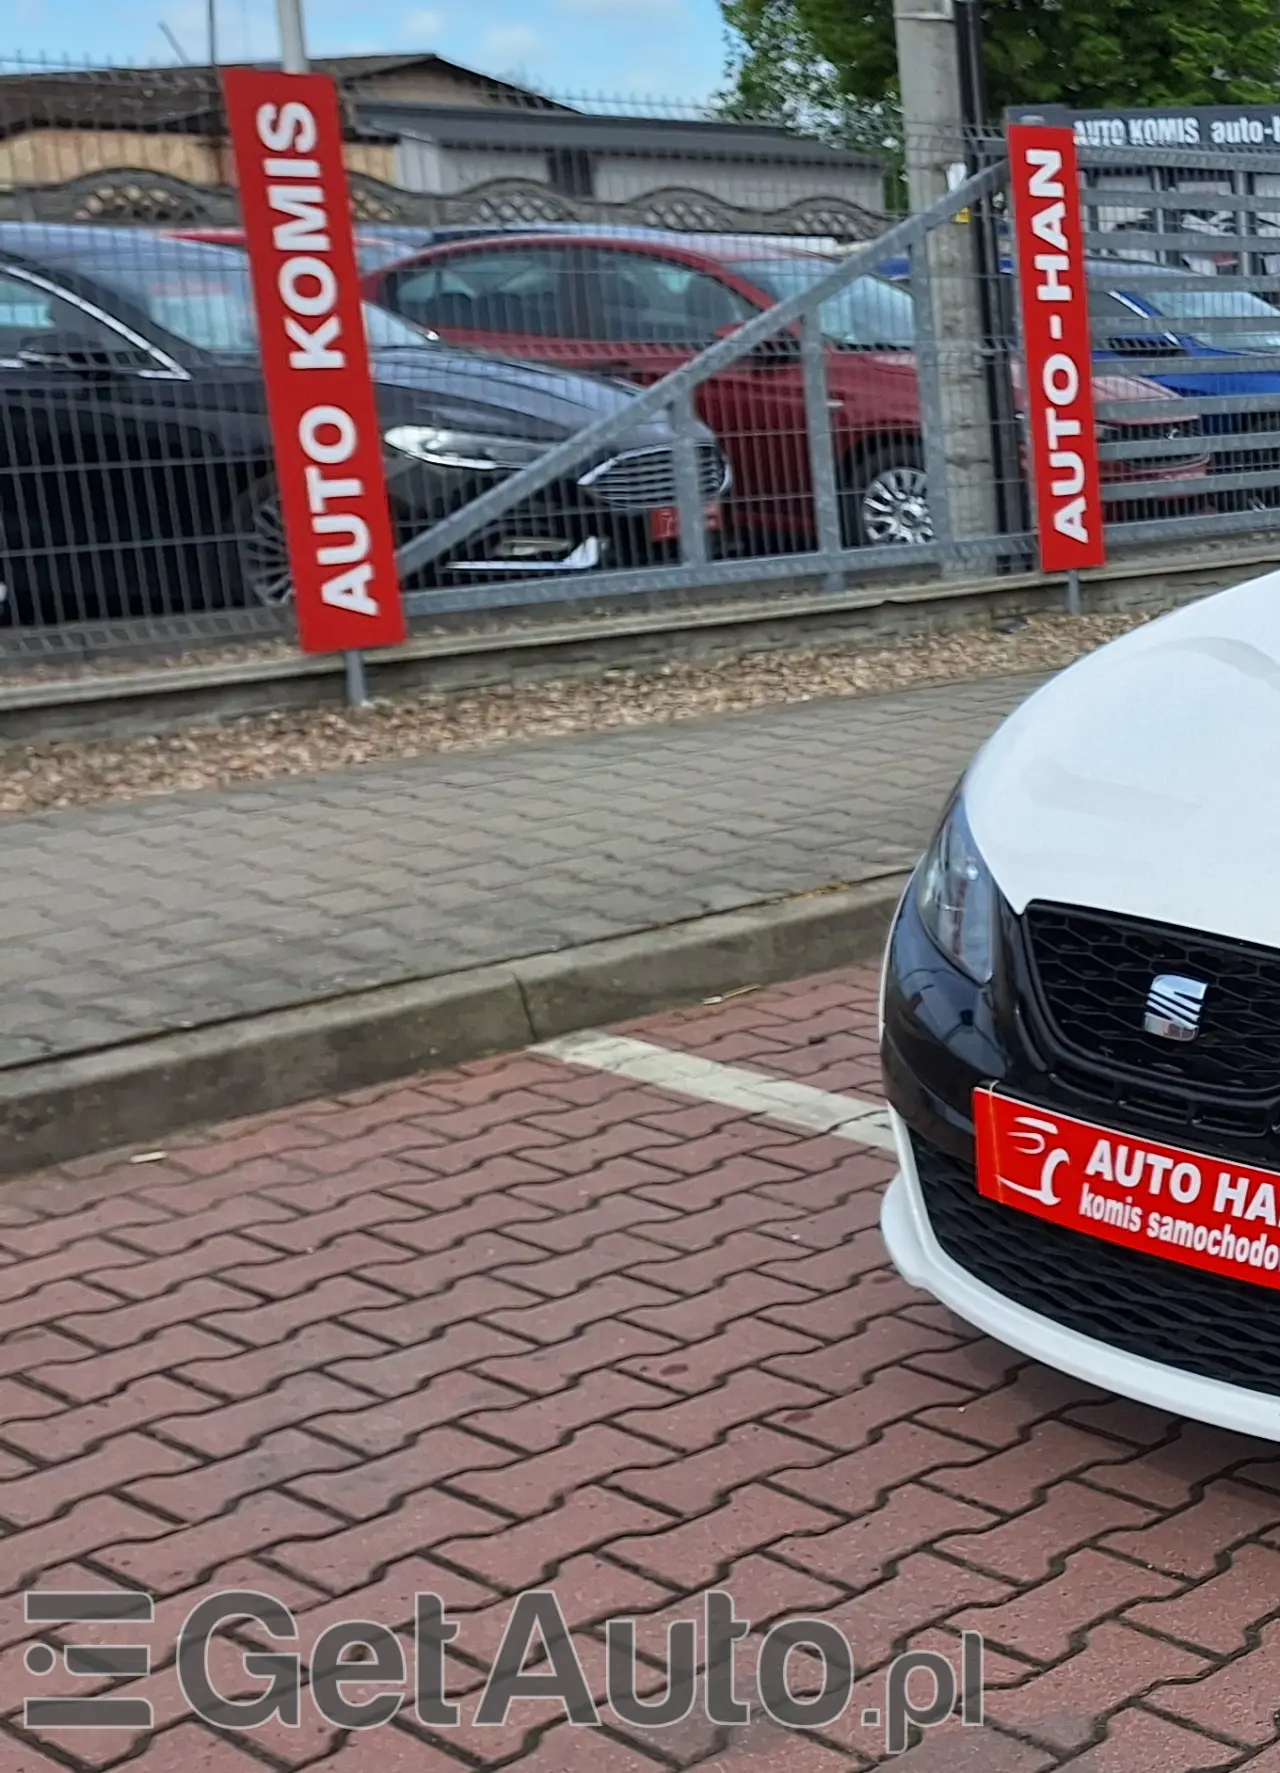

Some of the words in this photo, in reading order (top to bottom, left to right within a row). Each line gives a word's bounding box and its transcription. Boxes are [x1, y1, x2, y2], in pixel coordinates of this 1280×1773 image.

[1073, 119, 1125, 146] AUTO
[1128, 117, 1200, 146] KOMIS
[256, 101, 346, 369] KOMIS
[299, 405, 380, 617] AUTO
[1086, 1139, 1201, 1203] AUTO
[1079, 1182, 1142, 1232] komis
